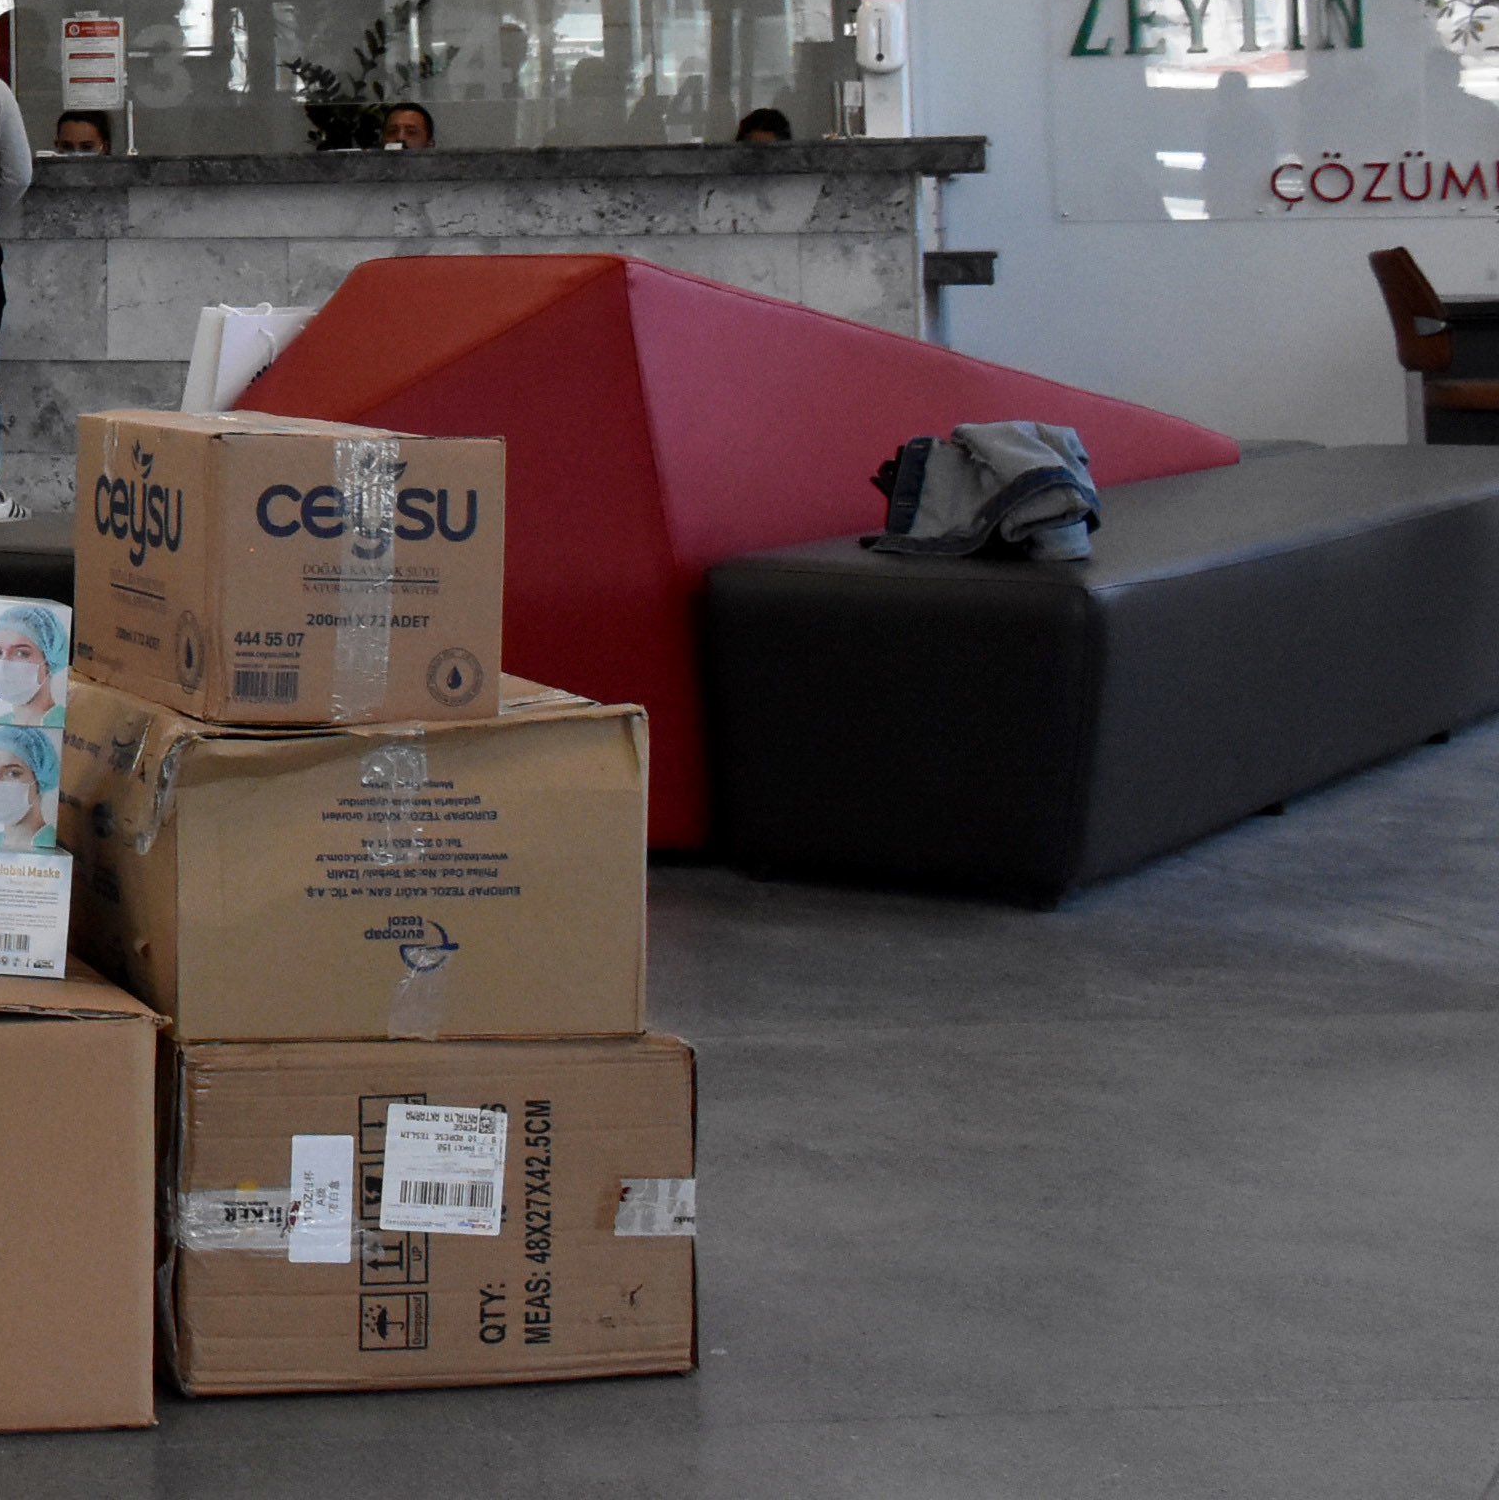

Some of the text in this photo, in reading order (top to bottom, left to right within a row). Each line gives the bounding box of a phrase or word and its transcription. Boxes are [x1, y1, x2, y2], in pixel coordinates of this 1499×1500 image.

[1270, 150, 1499, 212] ÇÖZÜM
[94, 474, 183, 566] ceysu
[390, 615, 430, 628] ADET
[234, 631, 305, 647] 444 55 07
[27, 866, 61, 880] Maske
[430, 887, 466, 897] TEZOL
[468, 886, 522, 897] EUROPAP
[387, 915, 424, 928] tezol
[364, 927, 425, 940] europap
[524, 1100, 552, 1344] MEAS: 48X27X42.5CM
[412, 1245, 422, 1262] UP
[479, 1283, 506, 1344] QTY:
